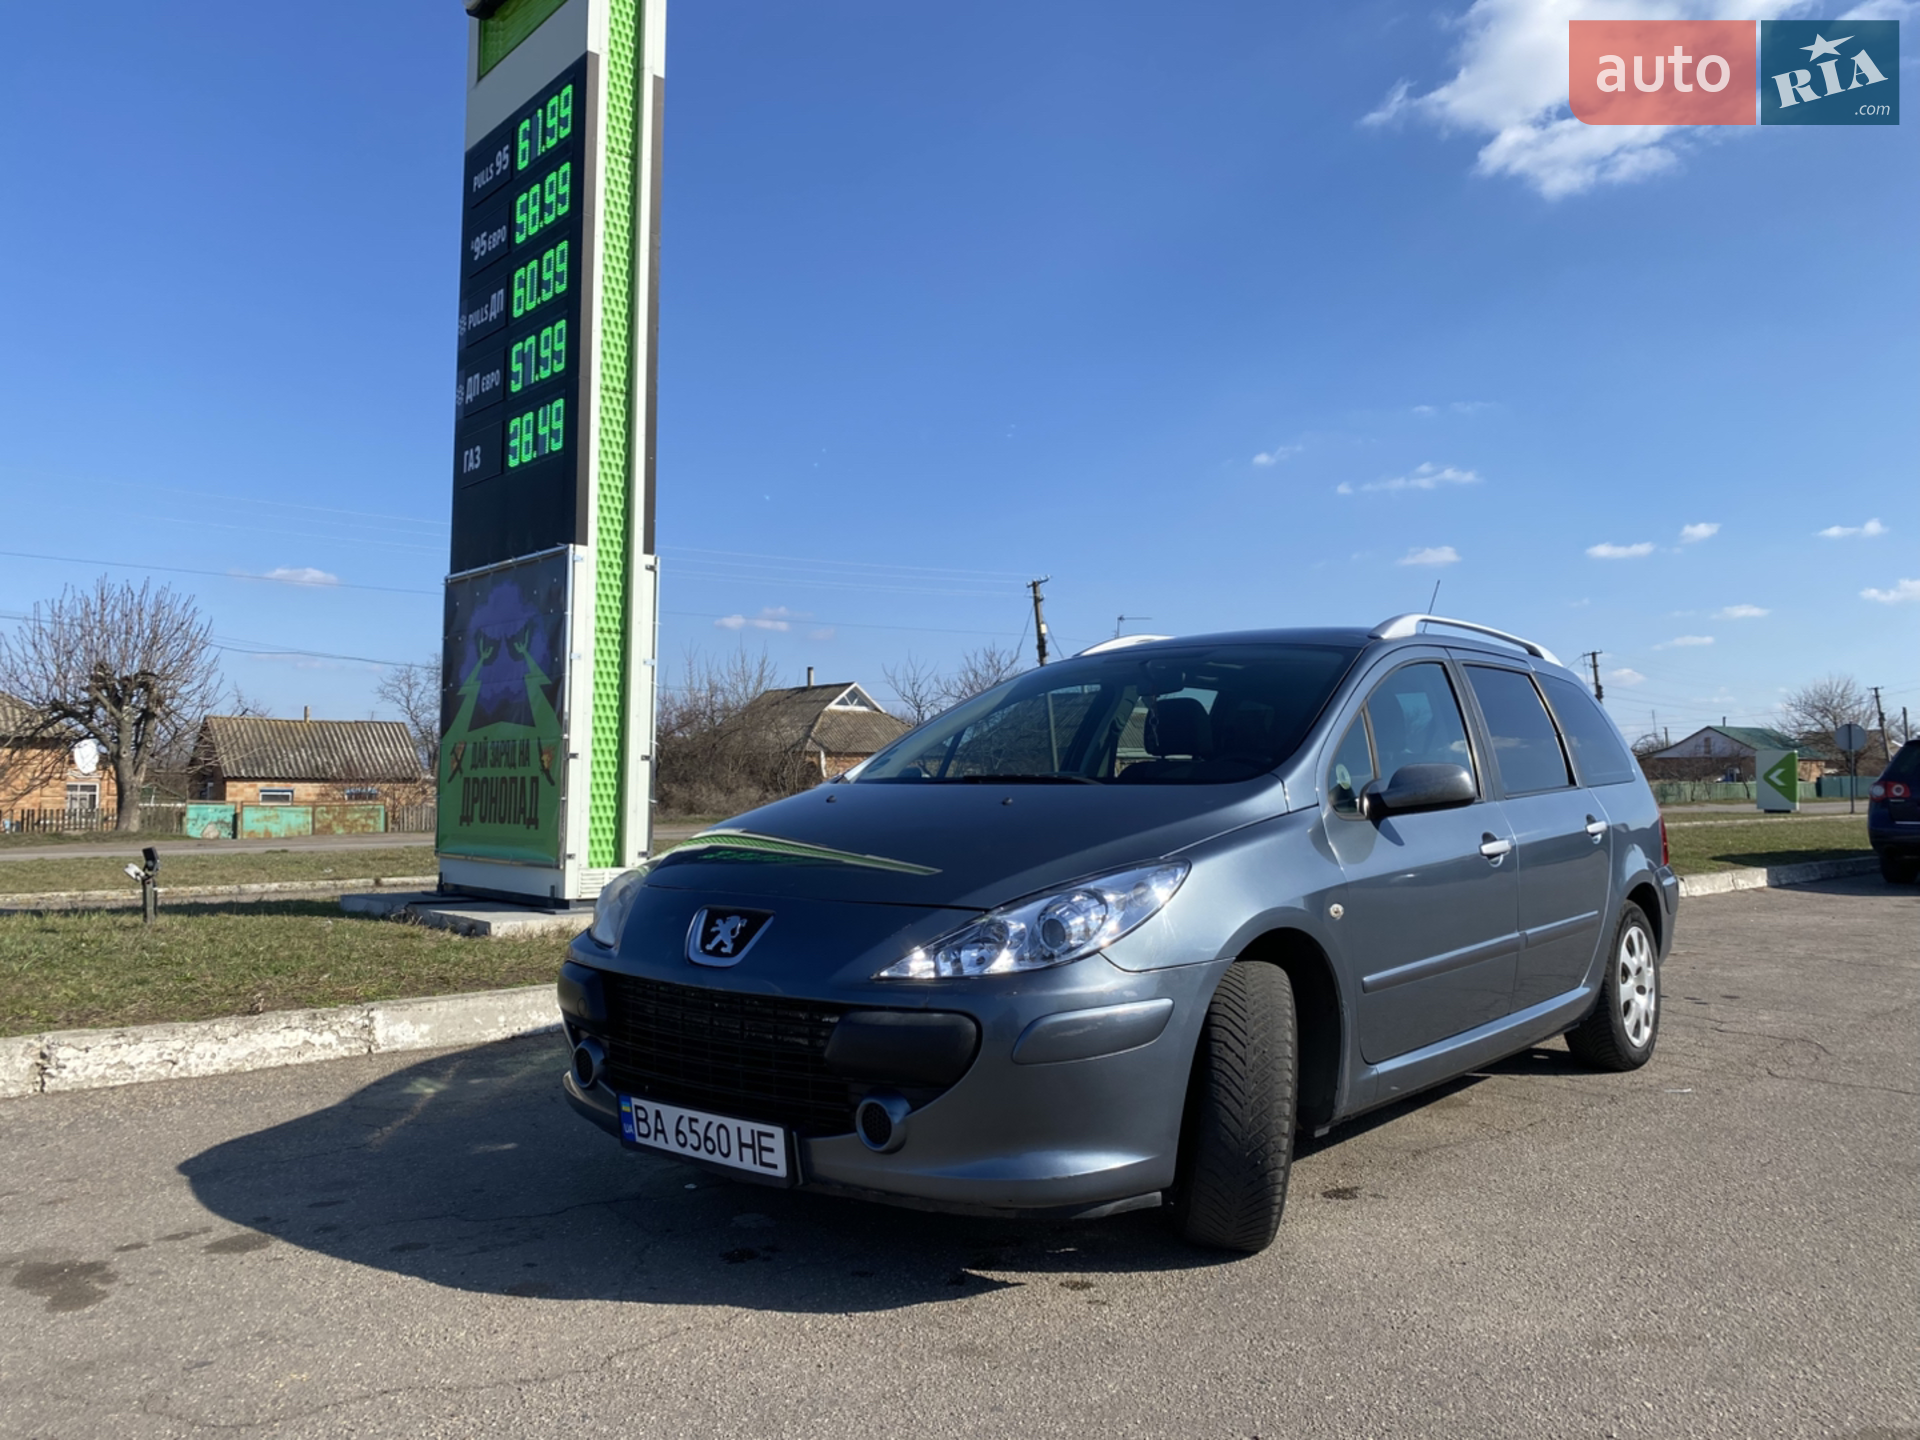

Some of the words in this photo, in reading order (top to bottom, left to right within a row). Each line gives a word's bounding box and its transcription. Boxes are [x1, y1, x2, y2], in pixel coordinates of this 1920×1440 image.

[472, 163, 495, 193] PULLS
[495, 143, 510, 176] 95
[516, 83, 573, 171] 61.99
[514, 161, 571, 244] 58.99
[468, 303, 489, 331] PULLS
[489, 288, 505, 322] ДП
[512, 240, 569, 318] 60.99
[465, 372, 480, 405] ДП
[510, 319, 567, 393] 57.99
[463, 445, 482, 474] ГАЗ
[507, 398, 565, 468] 38.49
[470, 736, 488, 771] ДАЙ
[490, 739, 517, 770] ЗАРЯД
[518, 738, 531, 768] НА
[459, 776, 539, 830] ДРОНОПАД
[624, 1123, 634, 1133] UA
[634, 1104, 669, 1145] BA
[675, 1115, 732, 1159] 6560
[737, 1126, 779, 1170] HE
